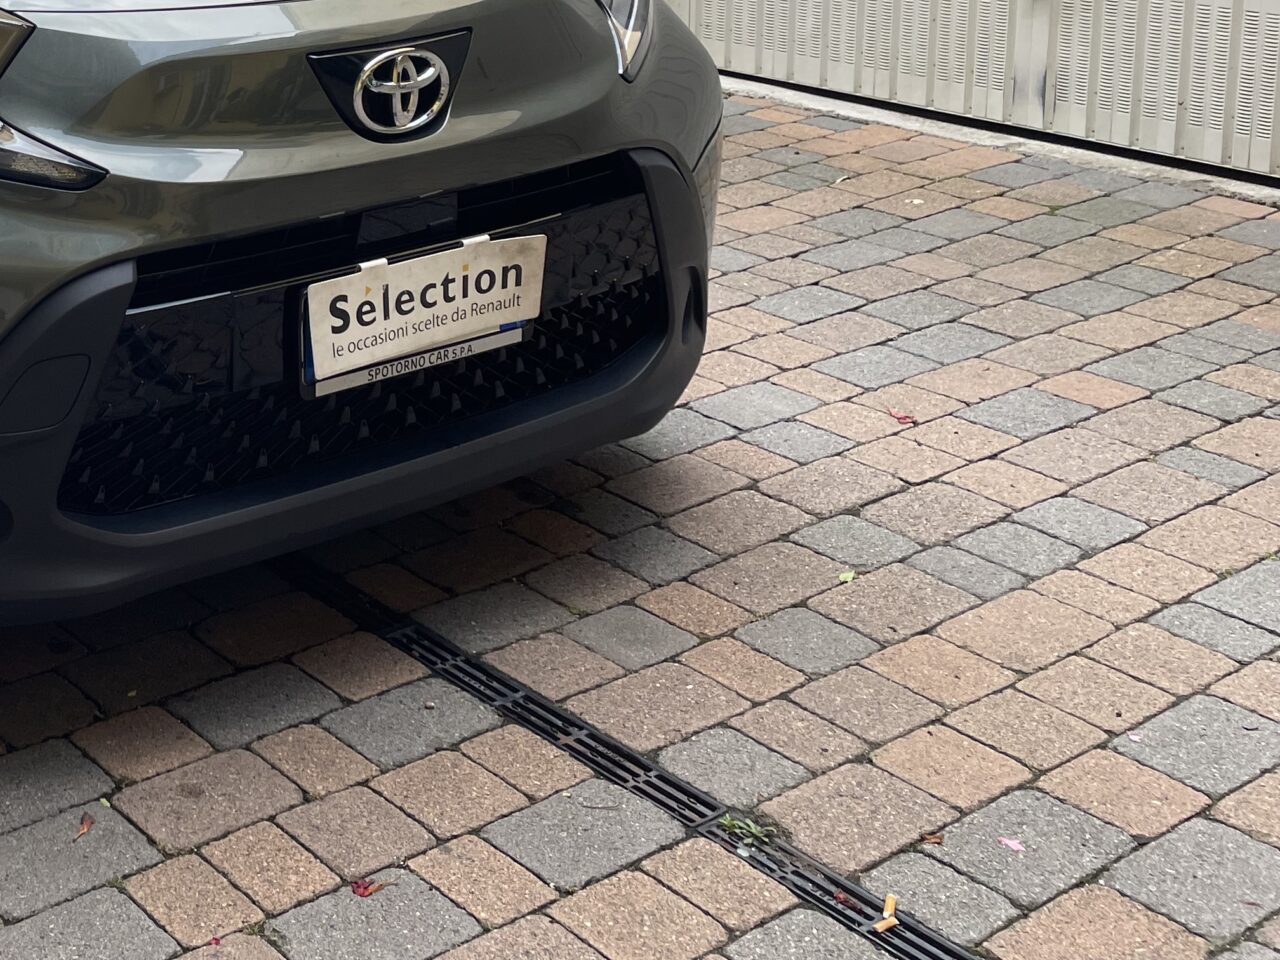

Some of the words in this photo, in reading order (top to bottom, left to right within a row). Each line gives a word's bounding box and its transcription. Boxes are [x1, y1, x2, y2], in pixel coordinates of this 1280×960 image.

[332, 342, 344, 358] le
[348, 321, 409, 353] occasioni
[412, 312, 448, 335] scelte
[451, 306, 467, 323] da
[471, 293, 521, 318] Renault
[367, 355, 426, 381] SPOTORNO
[428, 349, 450, 365] CAR
[452, 344, 475, 360] S.P.A.
